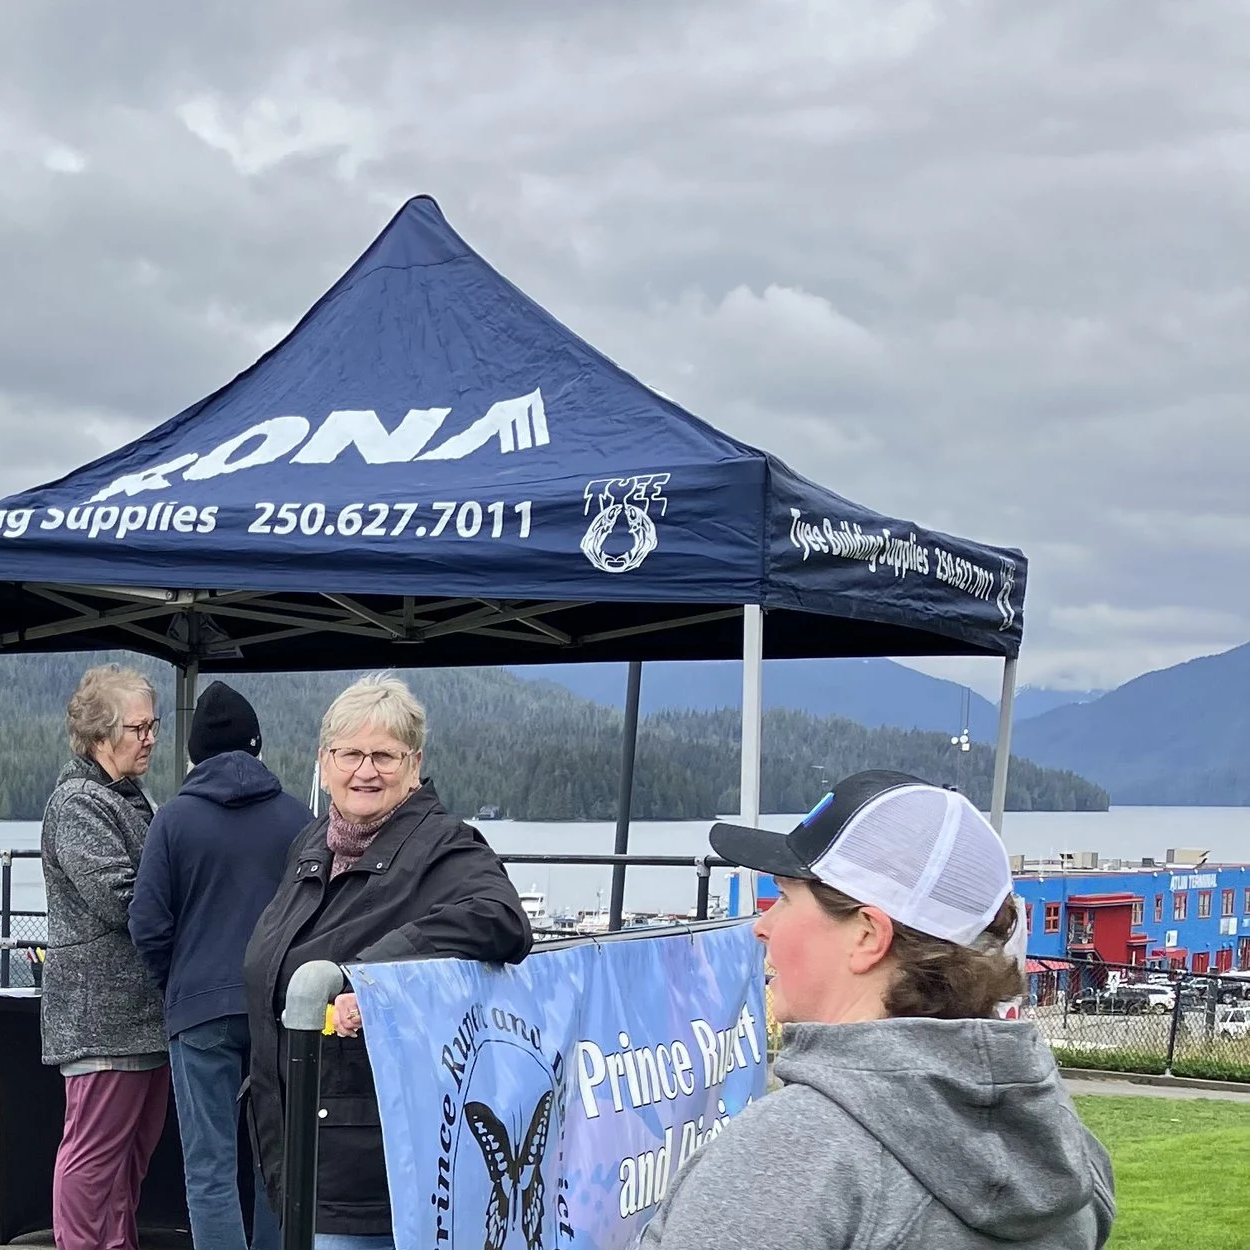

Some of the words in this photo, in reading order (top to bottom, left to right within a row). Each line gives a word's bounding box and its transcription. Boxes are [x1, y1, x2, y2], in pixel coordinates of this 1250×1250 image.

[248, 501, 533, 538] 250.627.7011
[790, 508, 829, 562] Tyee
[823, 517, 883, 573] Building
[879, 528, 930, 579] Supplies
[934, 547, 995, 601] 250.627.7011
[577, 1031, 695, 1119] Prince
[619, 1126, 673, 1219] and
